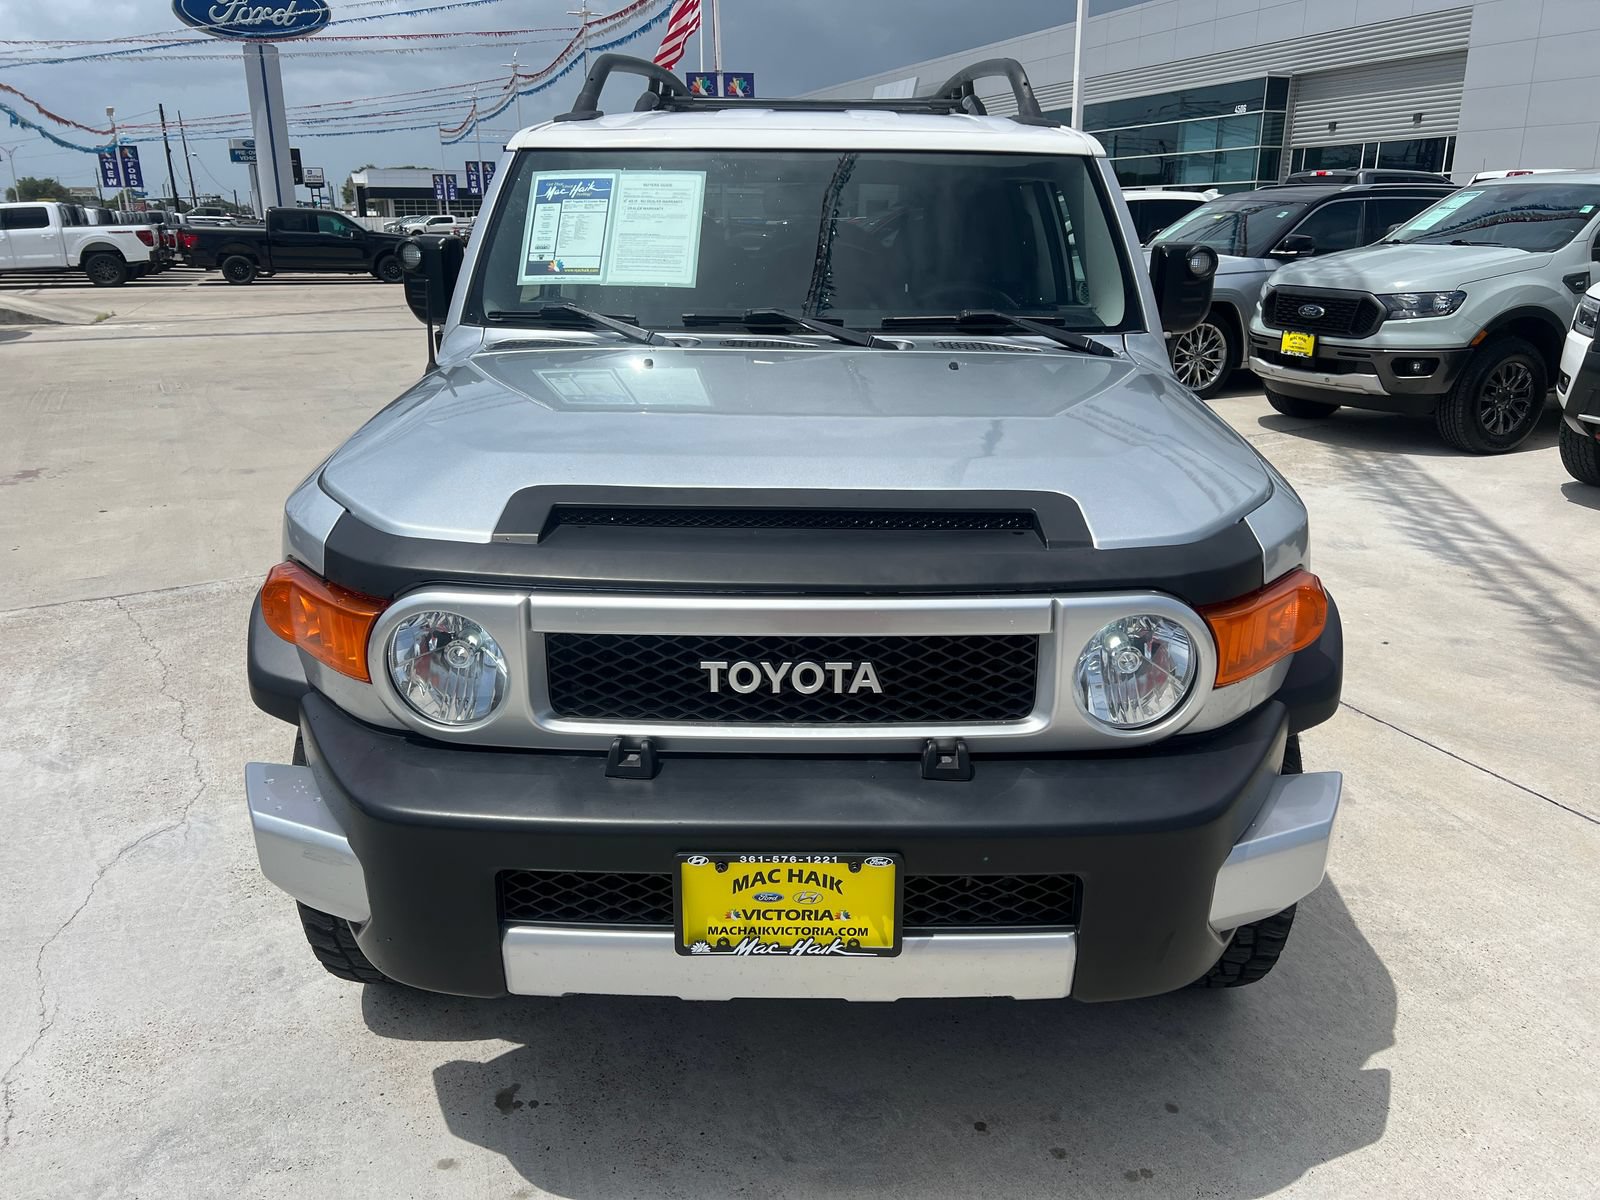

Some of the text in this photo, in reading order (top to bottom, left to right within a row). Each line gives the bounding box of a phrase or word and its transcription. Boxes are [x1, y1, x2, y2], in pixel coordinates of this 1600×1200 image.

[208, 0, 297, 26] Ford
[105, 162, 117, 186] NEW
[127, 161, 138, 186] FORD
[436, 184, 444, 200] NEW
[470, 174, 479, 194] NEW
[544, 180, 601, 201] Mac Haik
[700, 661, 883, 694] TOYOTA
[739, 855, 838, 864] 361-576-1221
[732, 868, 844, 896] MAC HAIK
[756, 893, 781, 902] Ford
[741, 909, 835, 921] VICTORIA
[707, 926, 869, 937] MACHAIKVICTORIA.COM
[731, 937, 860, 956] Mac Haik
